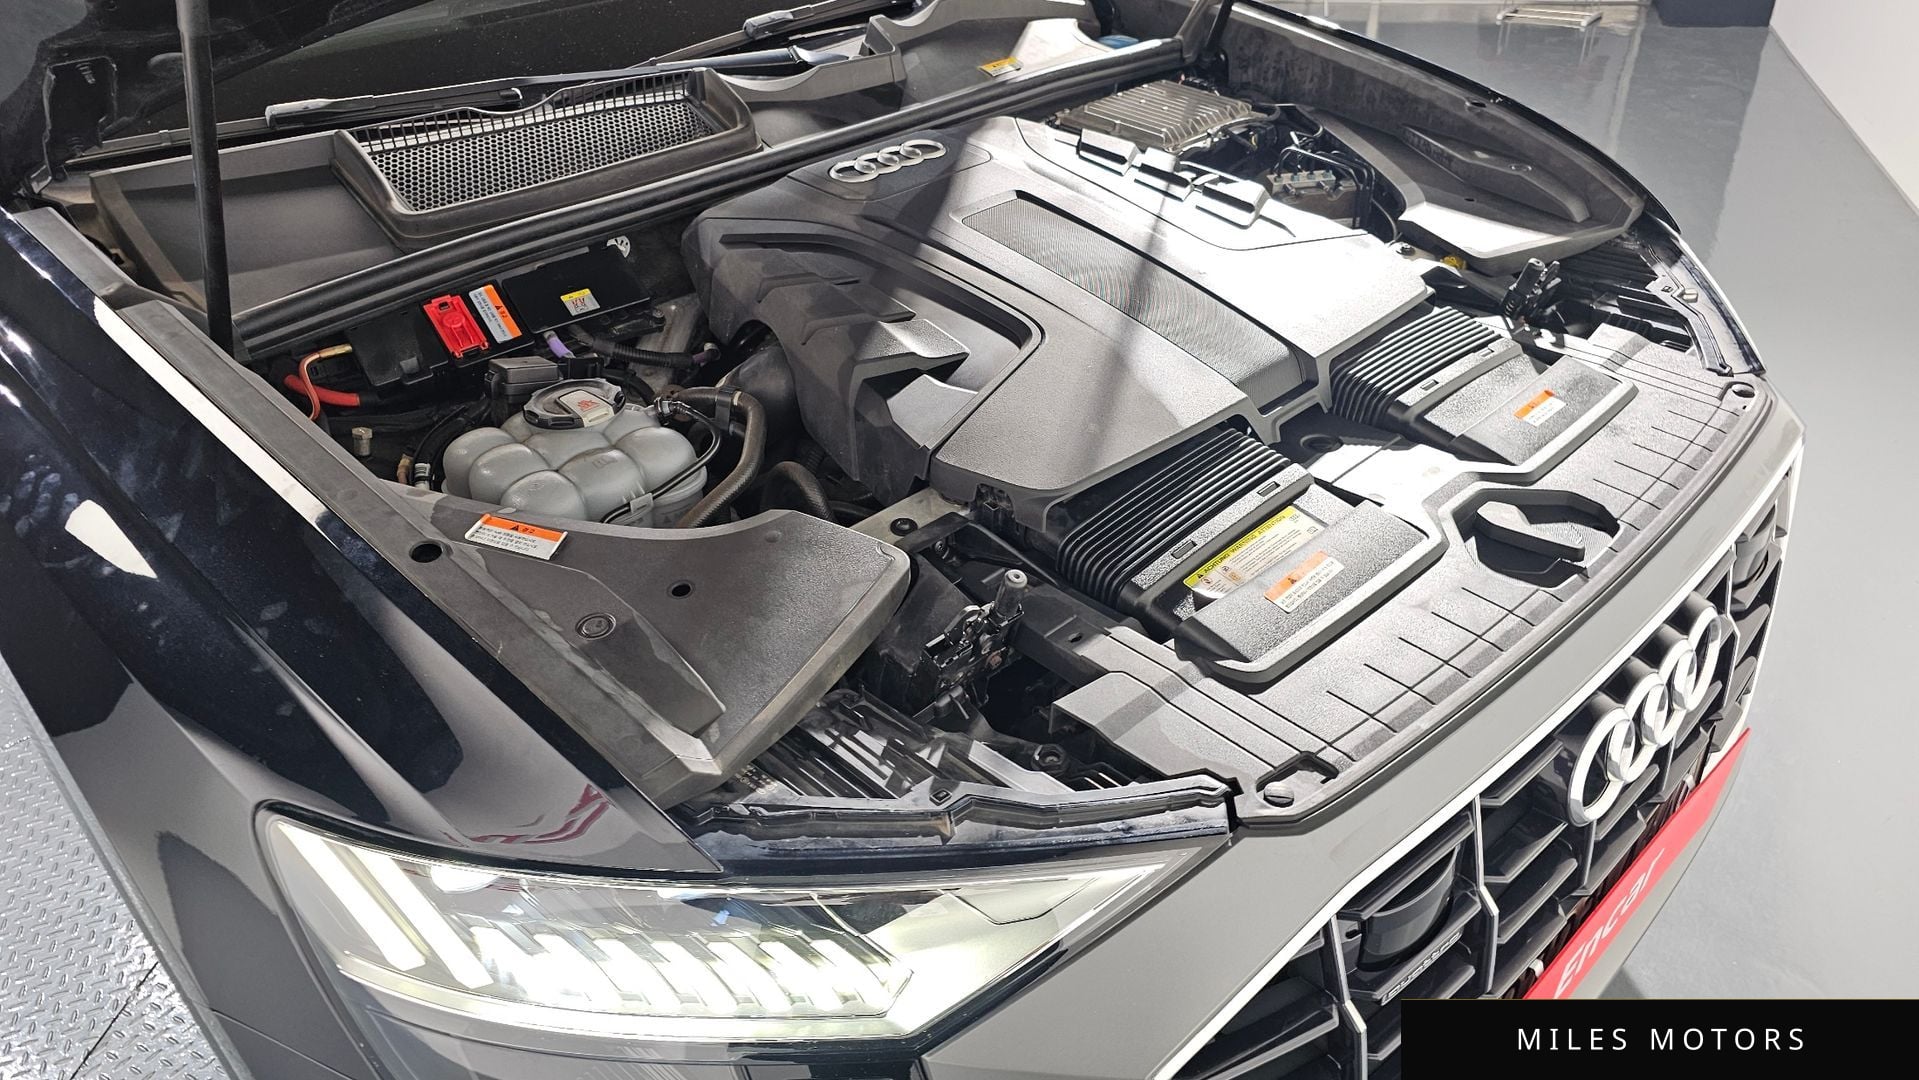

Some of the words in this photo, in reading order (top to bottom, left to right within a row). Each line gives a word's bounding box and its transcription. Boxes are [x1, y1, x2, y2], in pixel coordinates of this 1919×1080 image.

[1204, 553, 1230, 573] ACHTUNG
[1231, 534, 1257, 553] WARNING
[1258, 515, 1286, 535] ATTENTION
[1554, 847, 1665, 999] Encar
